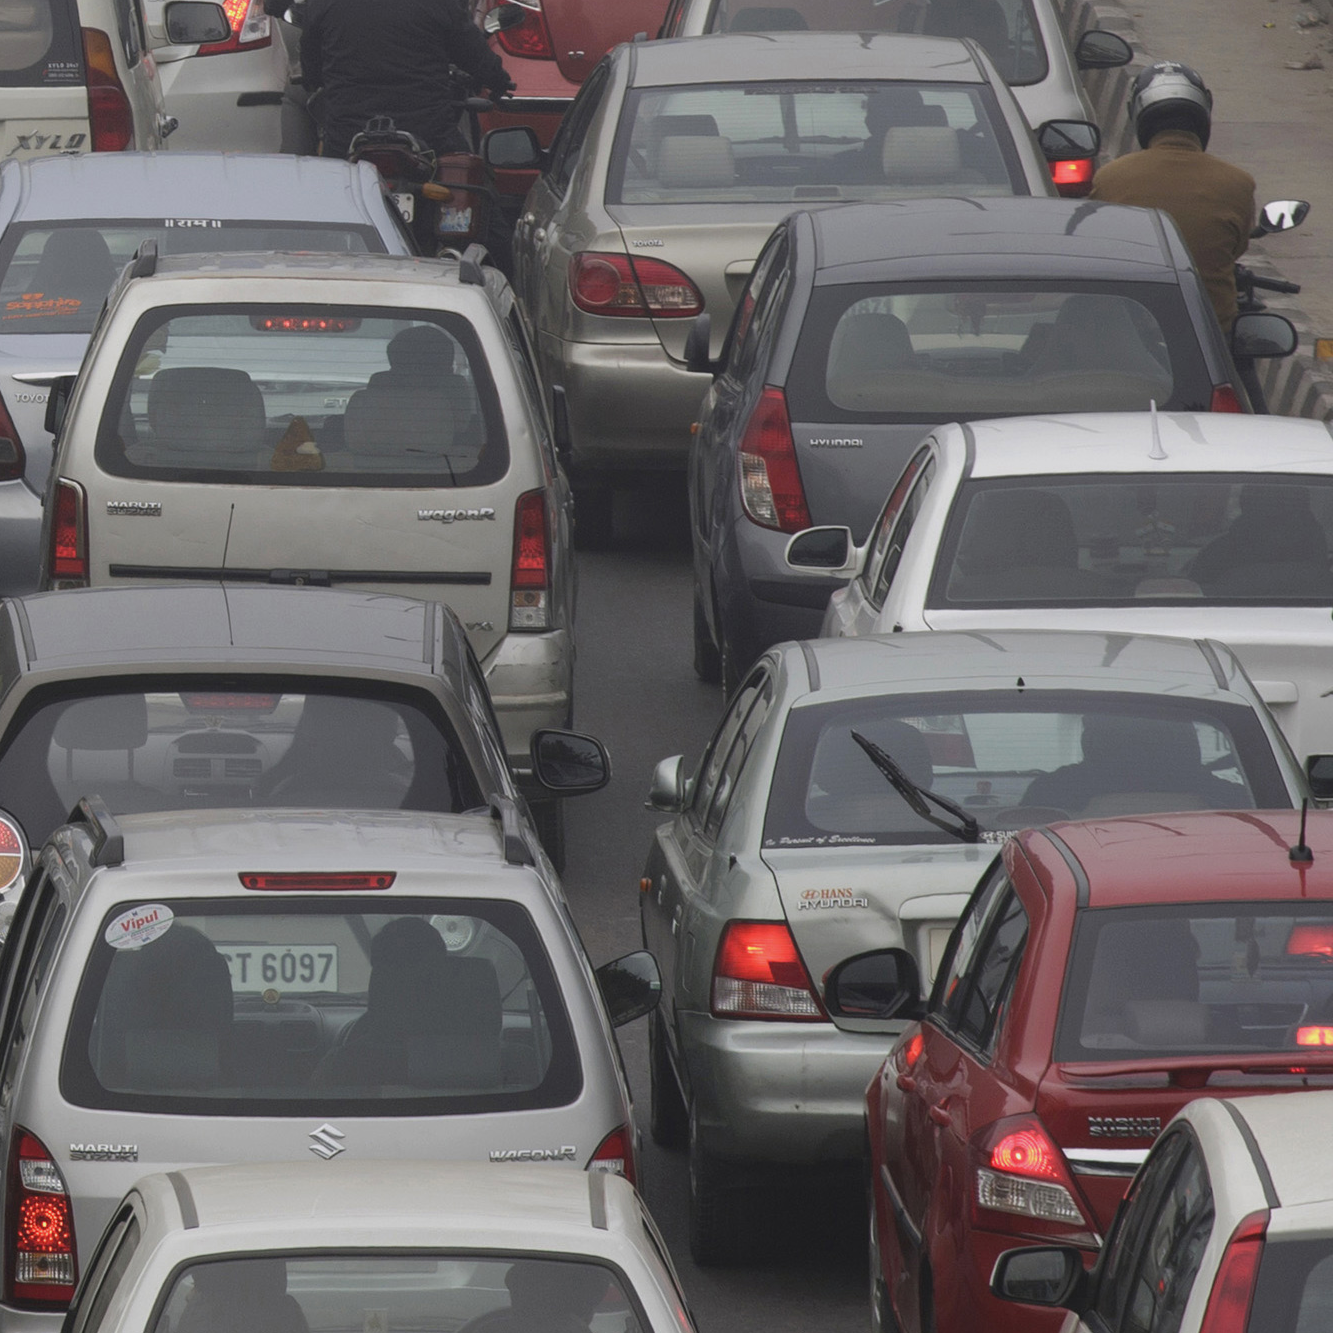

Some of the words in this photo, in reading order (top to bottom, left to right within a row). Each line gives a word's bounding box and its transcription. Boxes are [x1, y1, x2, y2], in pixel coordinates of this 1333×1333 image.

[9, 130, 87, 154] XYLO
[632, 239, 664, 247] TOYOTA
[810, 438, 863, 447] HYUNDAI
[107, 501, 162, 509] MARUTI
[418, 507, 496, 524] wagonR
[814, 835, 828, 845] of
[820, 887, 853, 899] HANS
[797, 897, 869, 911] HYUNDAI
[120, 909, 159, 933] Vipul
[261, 952, 334, 984] 6097
[1088, 1116, 1161, 1126] MARUTI
[1089, 1125, 1161, 1137] SUZUKI
[69, 1143, 138, 1153] MARUTI
[69, 1152, 139, 1162] SUZUKI
